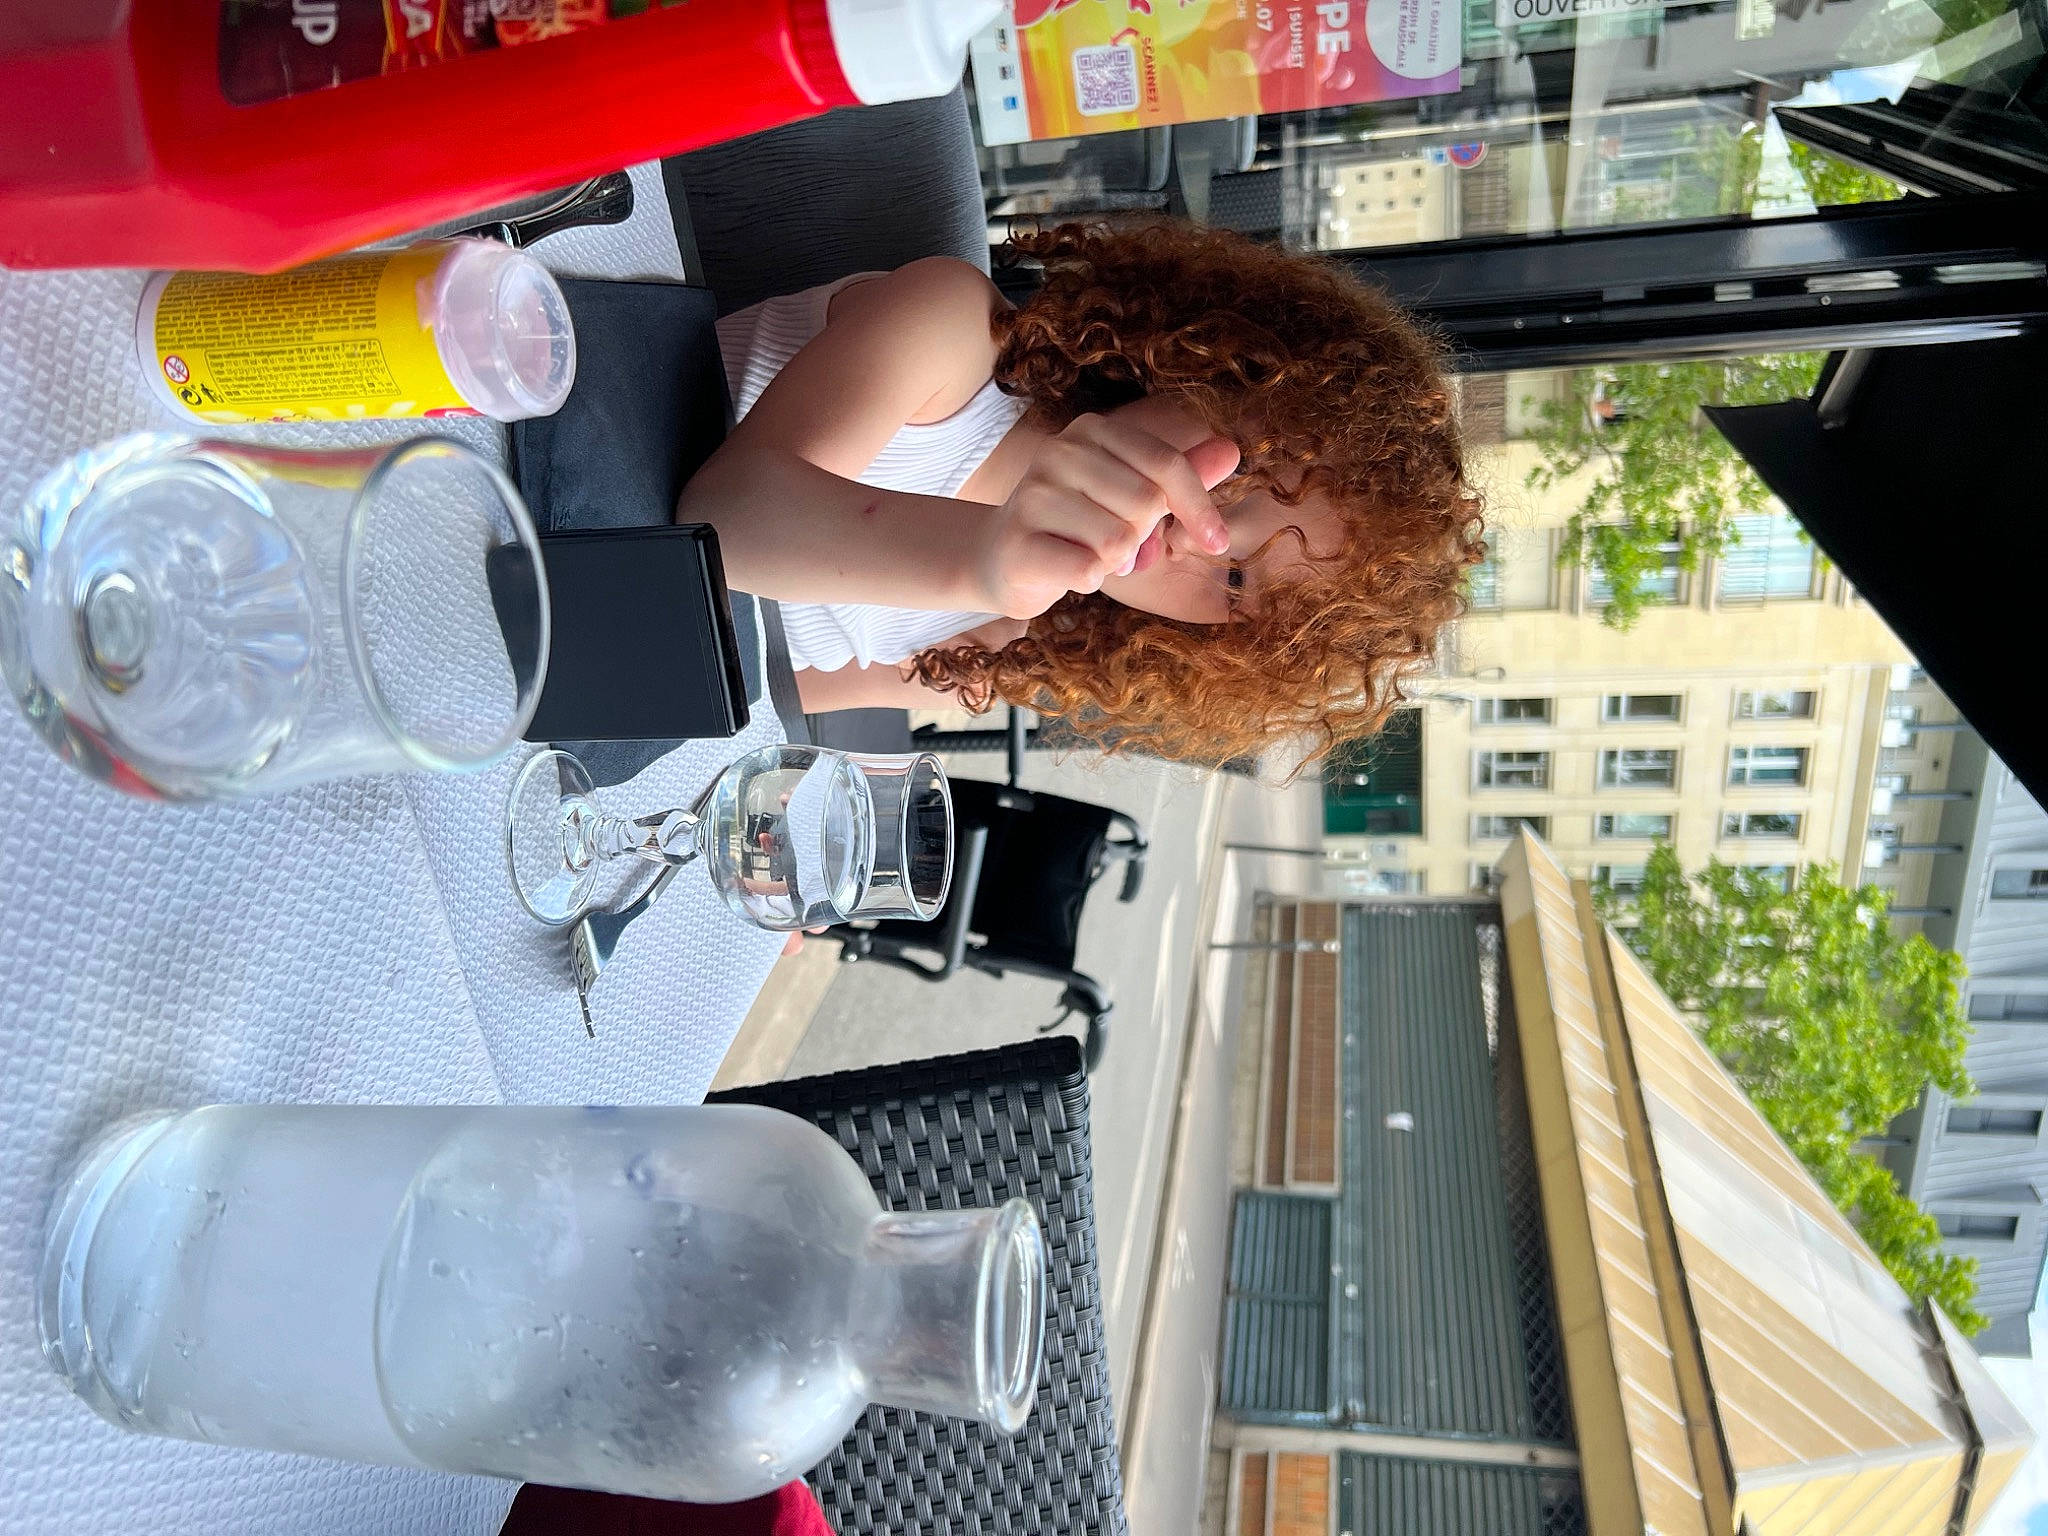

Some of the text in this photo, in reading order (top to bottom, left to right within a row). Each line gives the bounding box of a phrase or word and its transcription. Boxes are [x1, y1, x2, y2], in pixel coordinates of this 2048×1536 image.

[1315, 0, 1352, 56] PE
[1396, 15, 1408, 69] MUSICALE
[1427, 9, 1441, 64] GRATUITE
[1142, 37, 1159, 102] SCANNEZ
